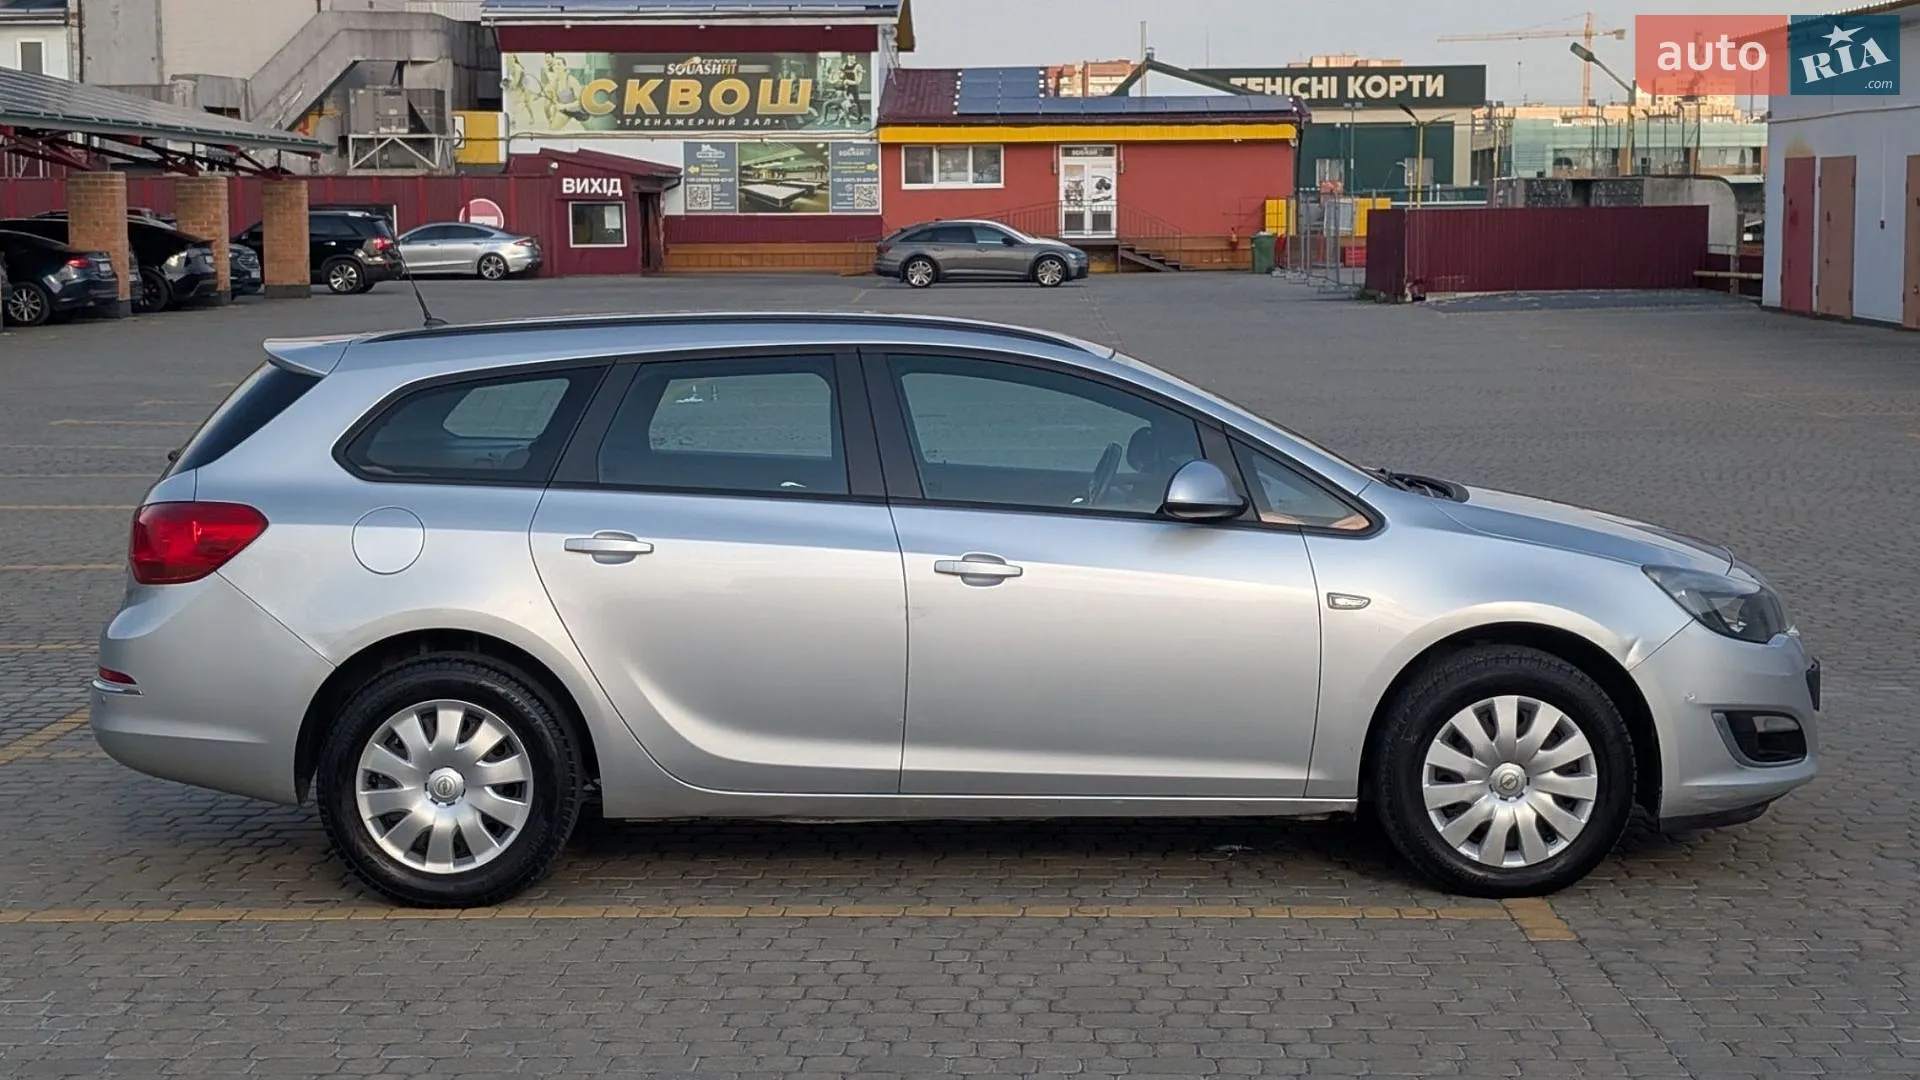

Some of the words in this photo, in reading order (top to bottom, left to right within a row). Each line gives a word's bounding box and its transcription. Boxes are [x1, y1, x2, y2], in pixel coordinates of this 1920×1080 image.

[581, 78, 812, 115] СКВОШ
[1347, 74, 1444, 99] КОРТИ
[625, 117, 736, 127] ТРЕНАЖЕРНИЙ
[743, 117, 772, 127] ЗАЛ
[562, 178, 623, 196] ВИХІД
